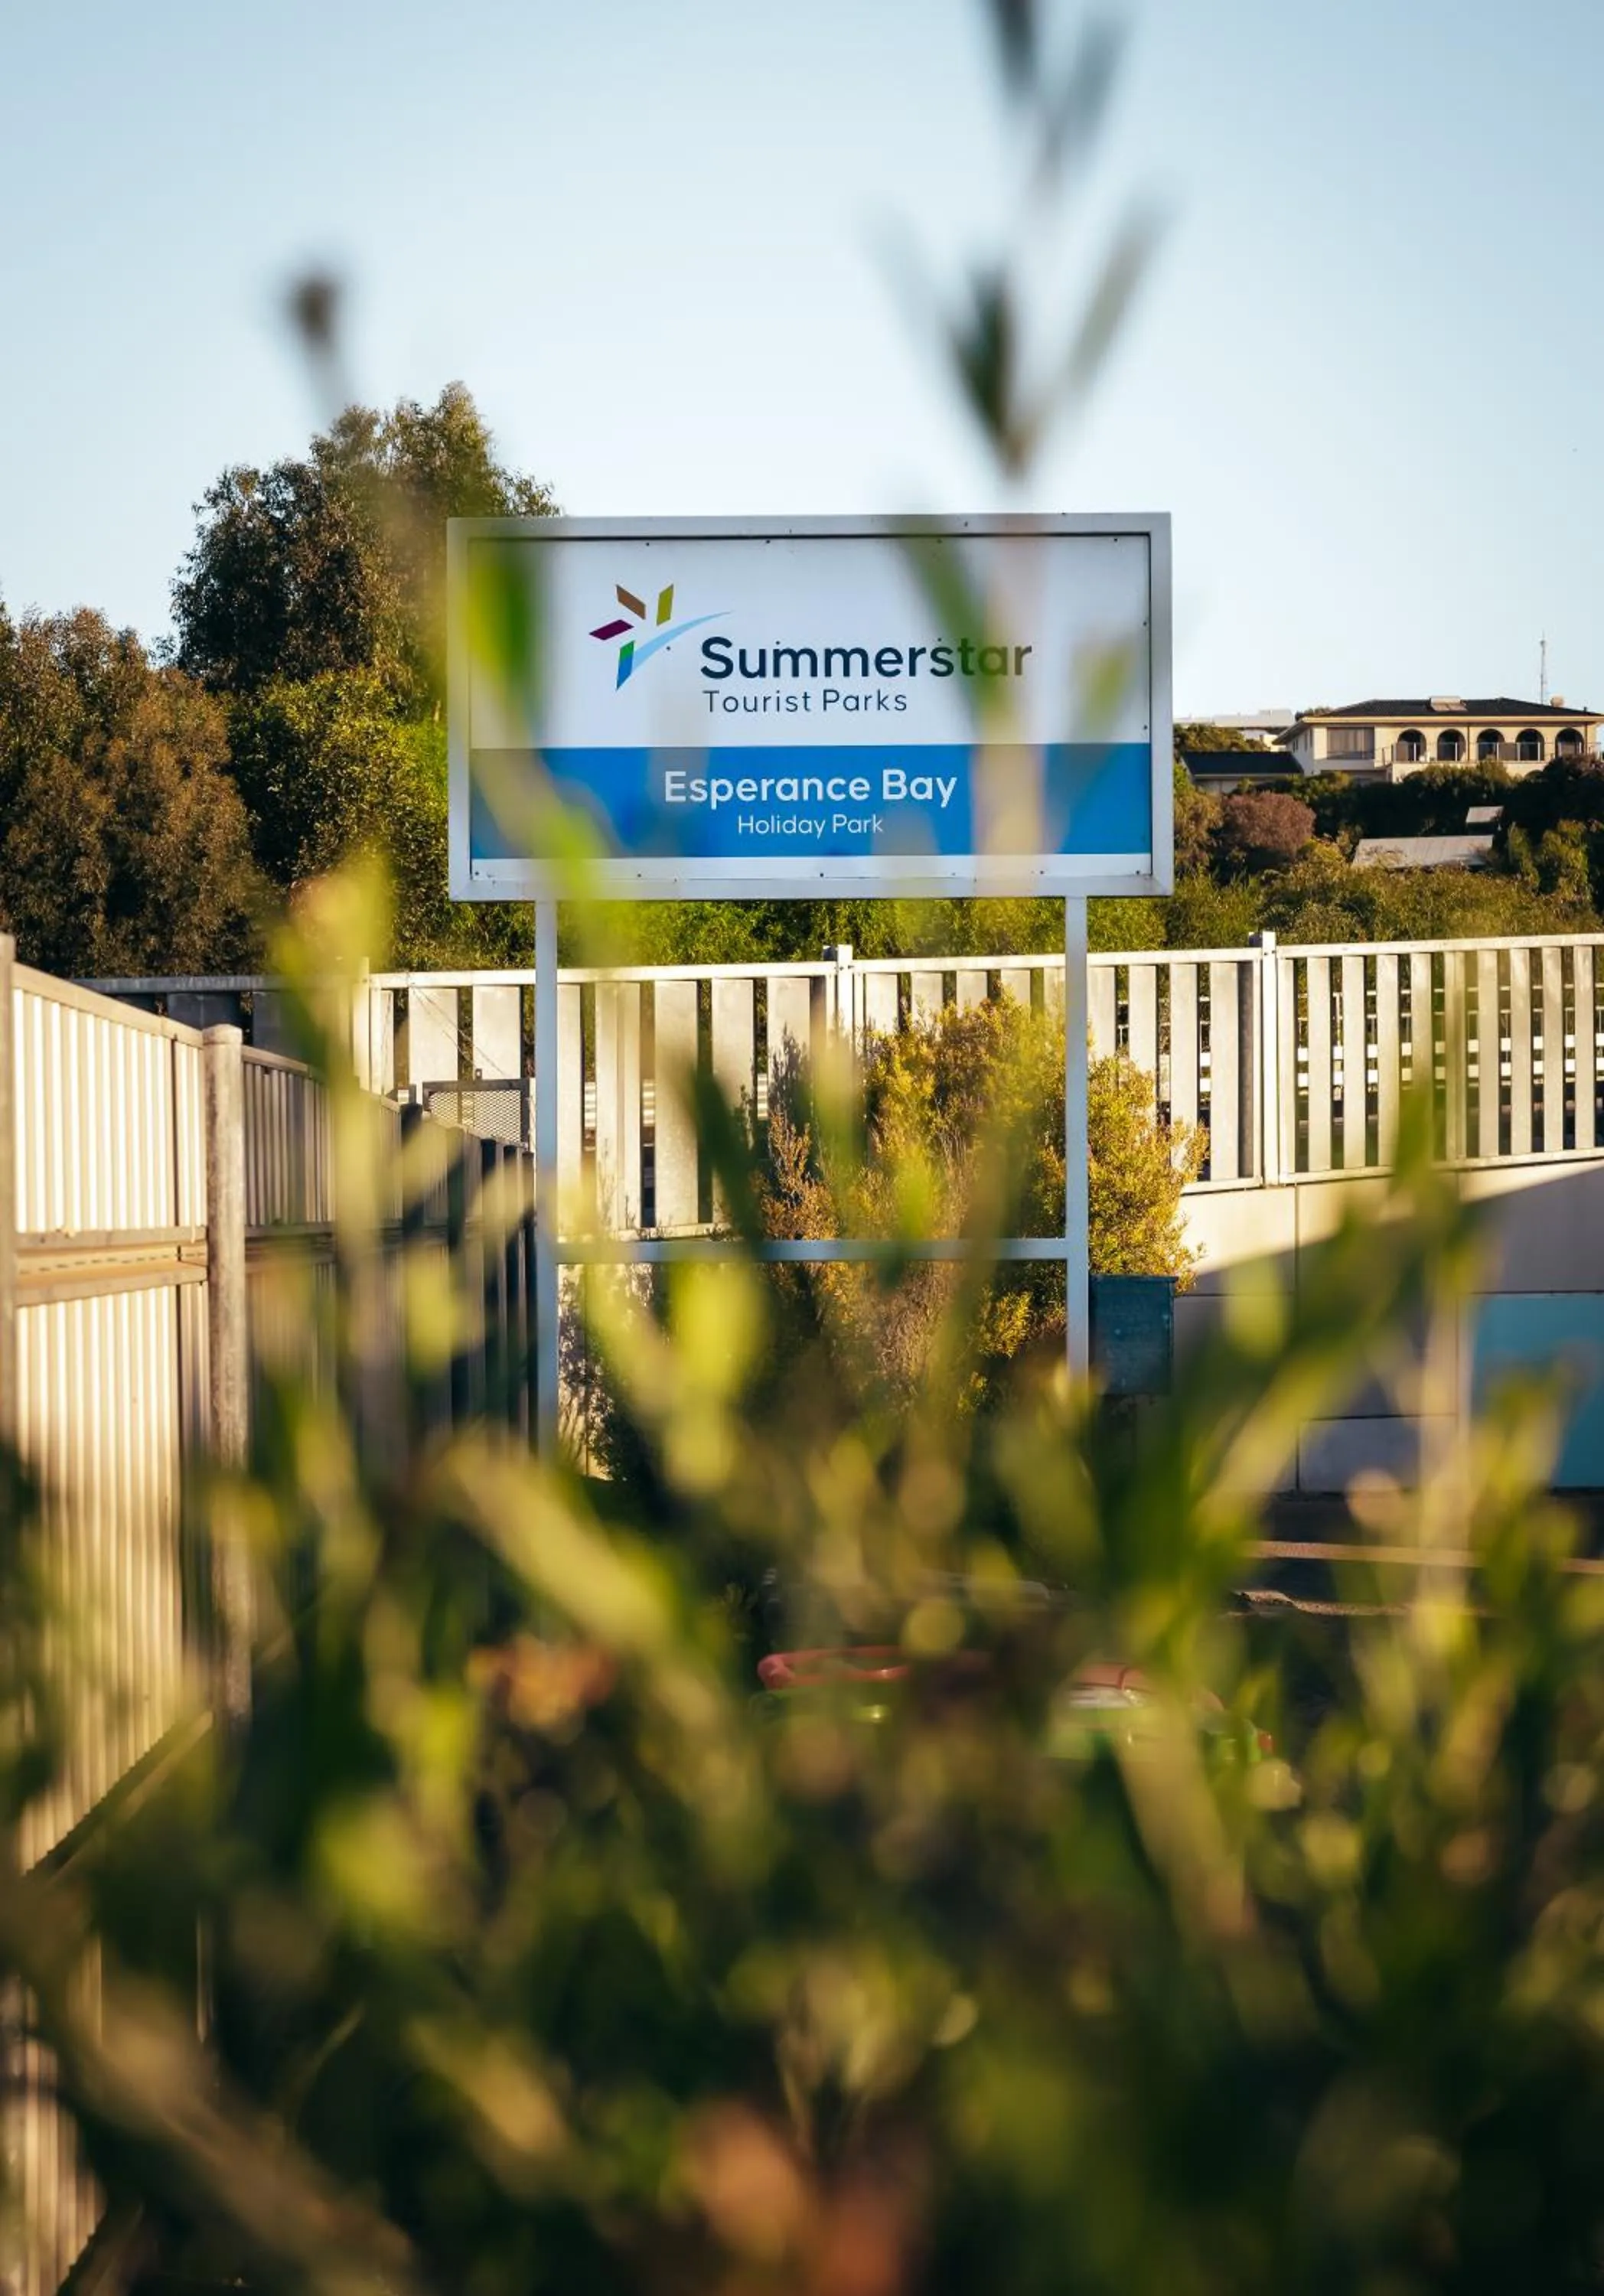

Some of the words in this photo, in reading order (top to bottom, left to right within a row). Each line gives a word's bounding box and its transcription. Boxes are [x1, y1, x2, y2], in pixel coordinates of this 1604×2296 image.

[700, 636, 1032, 679] Summerstar
[703, 690, 811, 713] Tourist
[823, 688, 908, 713] Parks
[664, 770, 870, 810] Esperance
[882, 768, 957, 808] Bay
[737, 814, 826, 840] Holiday
[833, 813, 884, 835] Park
